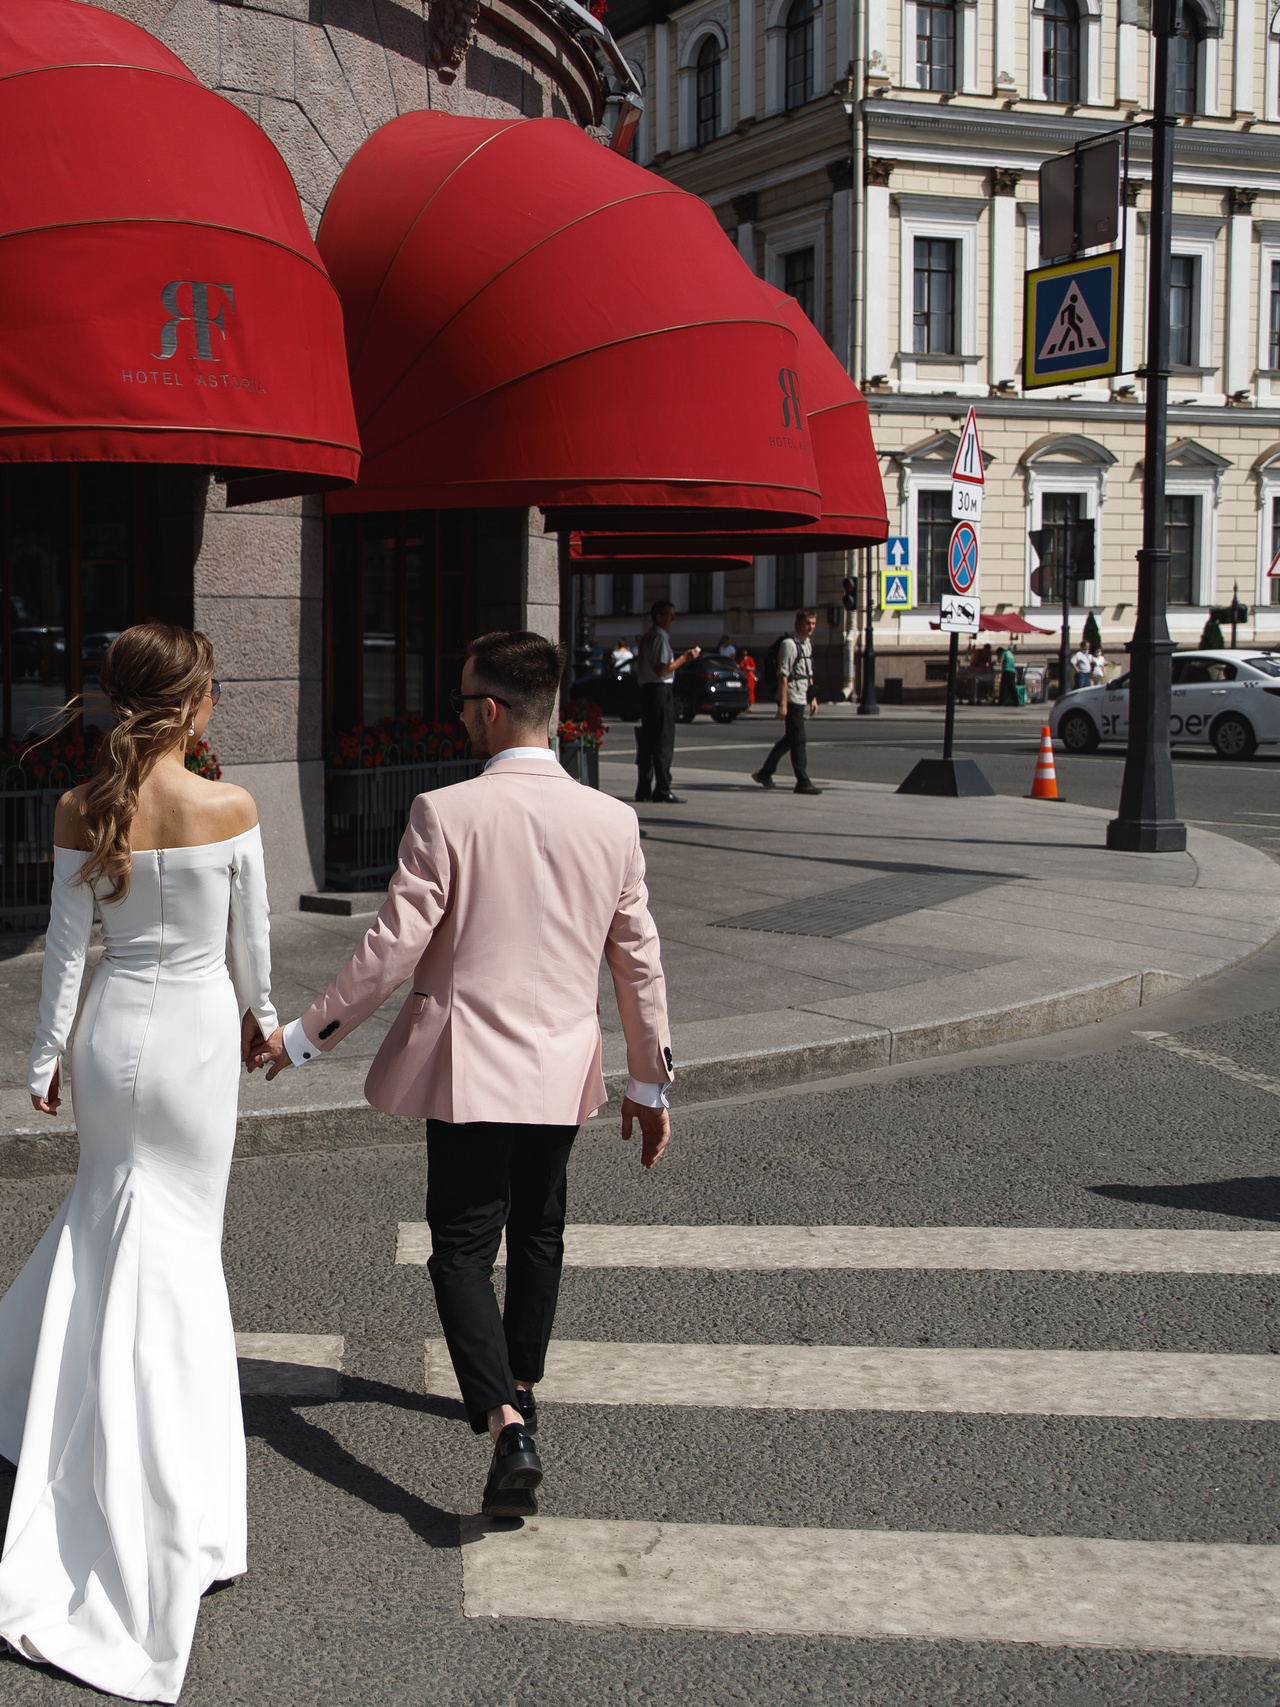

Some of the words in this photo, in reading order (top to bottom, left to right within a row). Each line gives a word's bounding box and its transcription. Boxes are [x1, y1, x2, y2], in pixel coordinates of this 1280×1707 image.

[121, 369, 184, 386] HOTEL
[196, 373, 268, 394] ASTORIA
[768, 436, 797, 450] HOTEL
